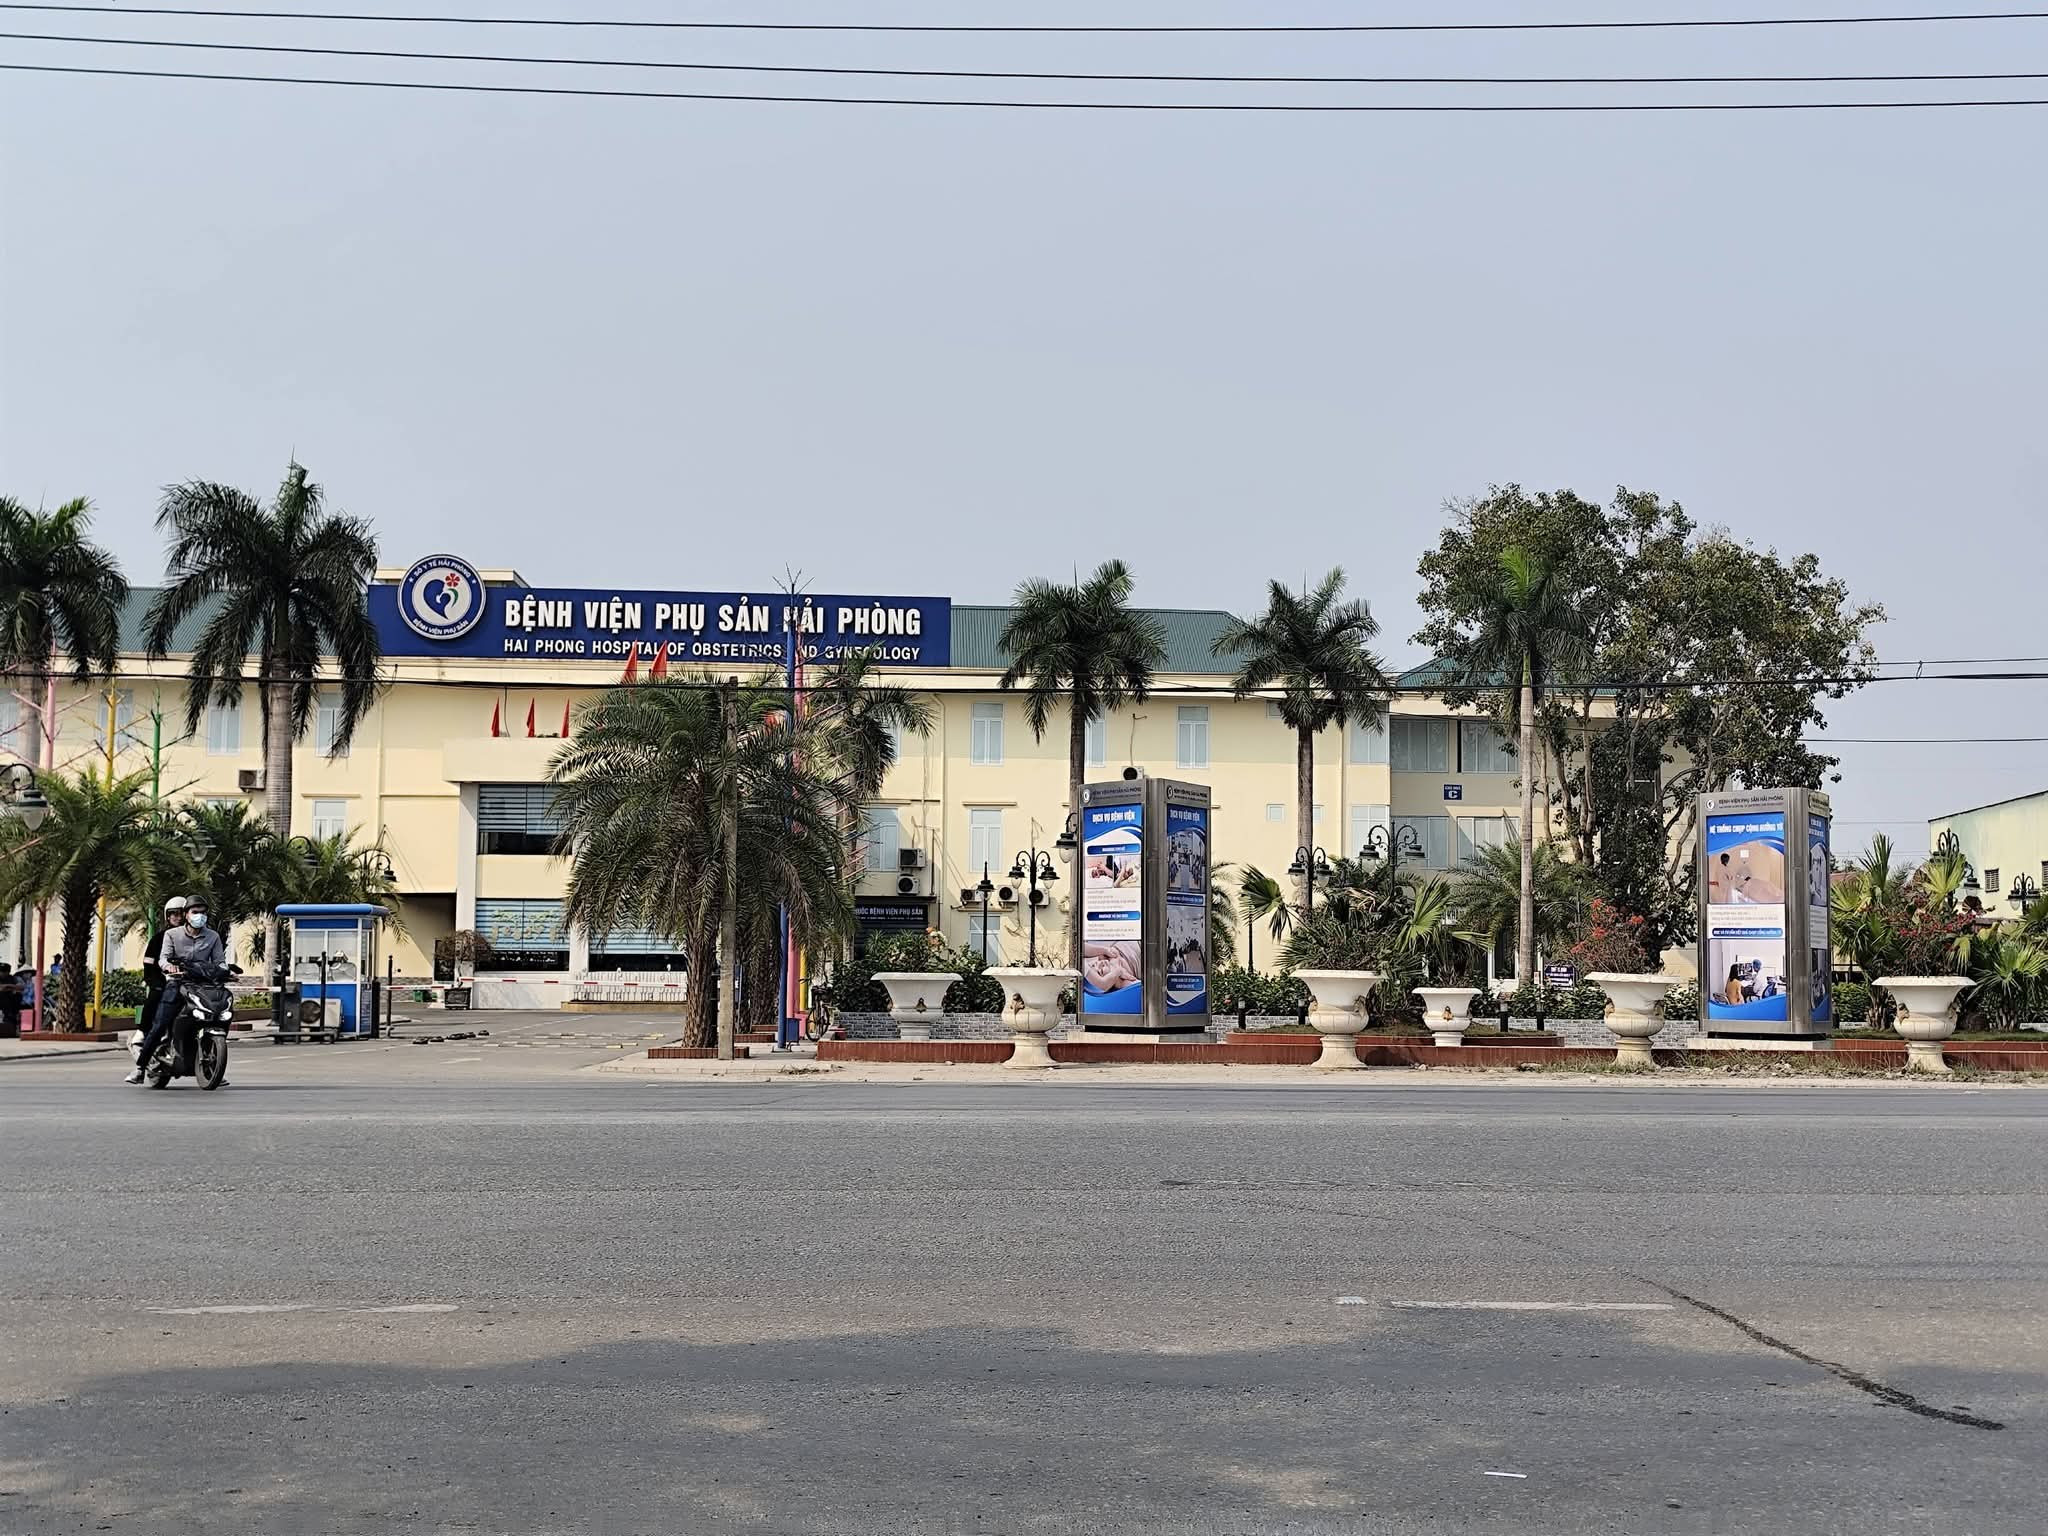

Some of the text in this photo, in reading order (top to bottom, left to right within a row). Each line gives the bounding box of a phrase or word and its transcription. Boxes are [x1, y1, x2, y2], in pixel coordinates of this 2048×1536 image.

[505, 594, 921, 636] BỆNH VIỆN PHỤ SẢN HẢI PHÒNG
[504, 638, 528, 652] HAI
[535, 639, 585, 653] PHONG
[667, 642, 686, 655] OF
[692, 642, 782, 658] OBSTETRICS
[1448, 790, 1458, 799] C
